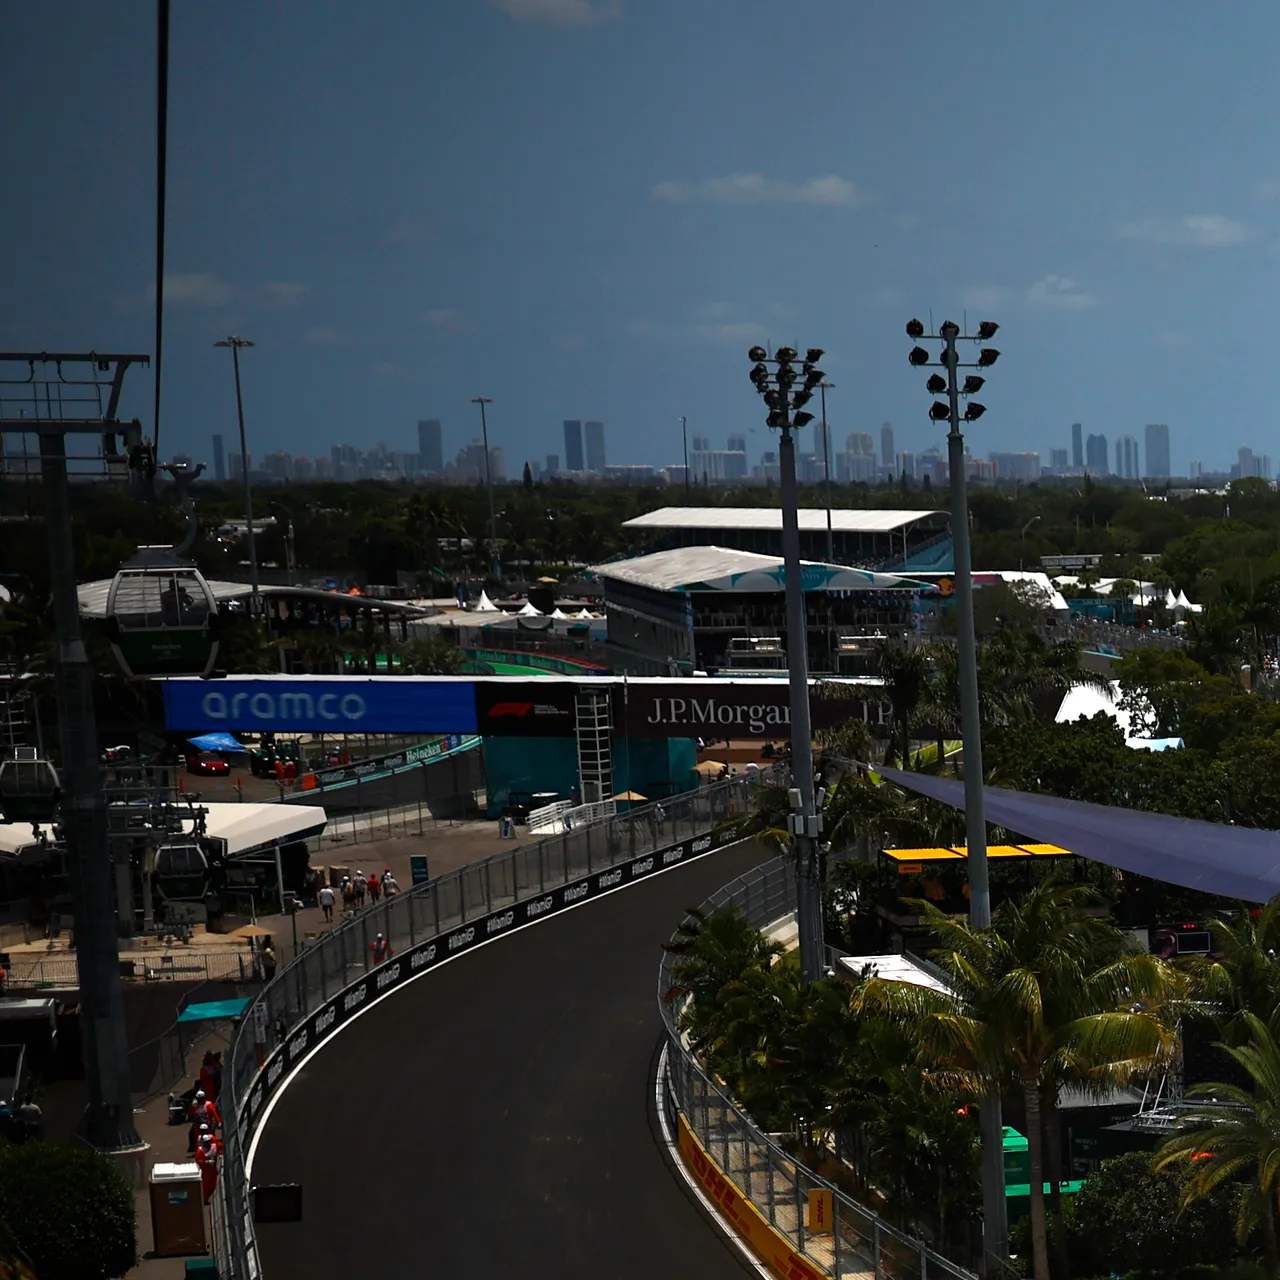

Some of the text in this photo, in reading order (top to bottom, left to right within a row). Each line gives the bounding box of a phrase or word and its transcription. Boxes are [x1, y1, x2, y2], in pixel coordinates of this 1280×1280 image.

[202, 691, 367, 720] aramco
[405, 744, 442, 765] Heineken
[527, 896, 553, 918] #MiamiGP
[487, 911, 514, 934] #MiamiGP
[449, 926, 475, 951] #MiamiGP
[691, 1142, 744, 1222] DHL
[817, 1198, 825, 1225] DHL
